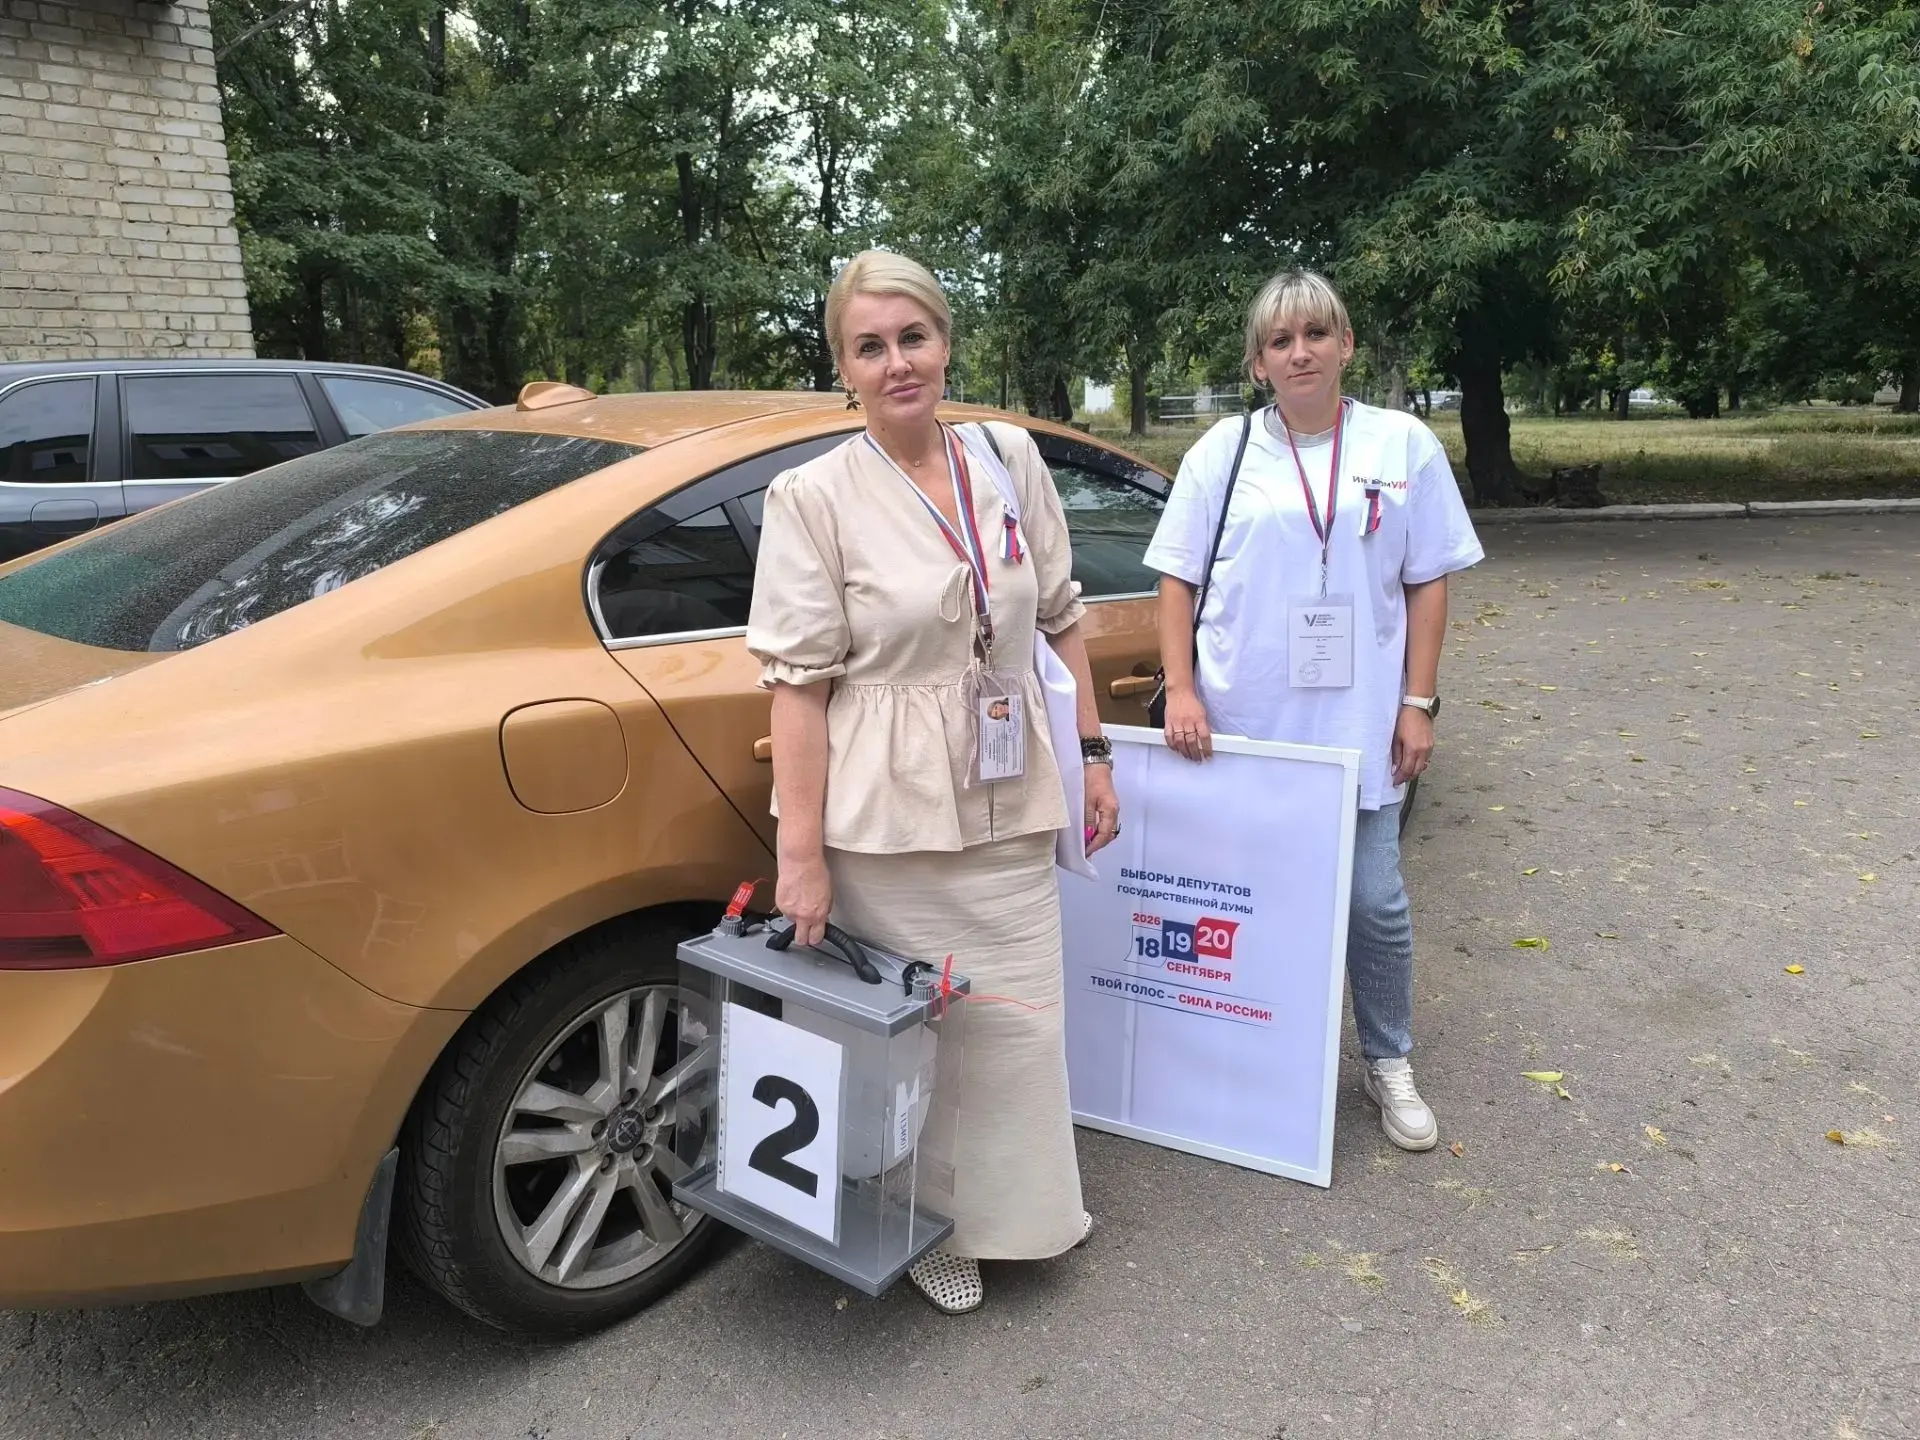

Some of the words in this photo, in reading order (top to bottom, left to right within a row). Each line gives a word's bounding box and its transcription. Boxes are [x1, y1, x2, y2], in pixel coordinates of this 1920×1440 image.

[1120, 868, 1174, 885] ВЫБОРЫ
[1177, 877, 1252, 898] ДЕПУТАТОВ
[1117, 884, 1218, 909] ГОСУДАРСТВЕННОЙ
[1220, 902, 1254, 915] ДУМЫ
[1132, 913, 1161, 926] 2026
[1135, 936, 1160, 958] 18
[1165, 930, 1191, 953] 19
[1197, 926, 1230, 950] 20
[1166, 961, 1232, 982] СЕНТЯБРЯ
[1090, 975, 1122, 990] ТВОЙ
[1125, 982, 1165, 1000] ГОЛОС
[1178, 994, 1212, 1009] СИЛА
[1216, 1001, 1272, 1021] РОССИИ!
[748, 1074, 820, 1198] 2
